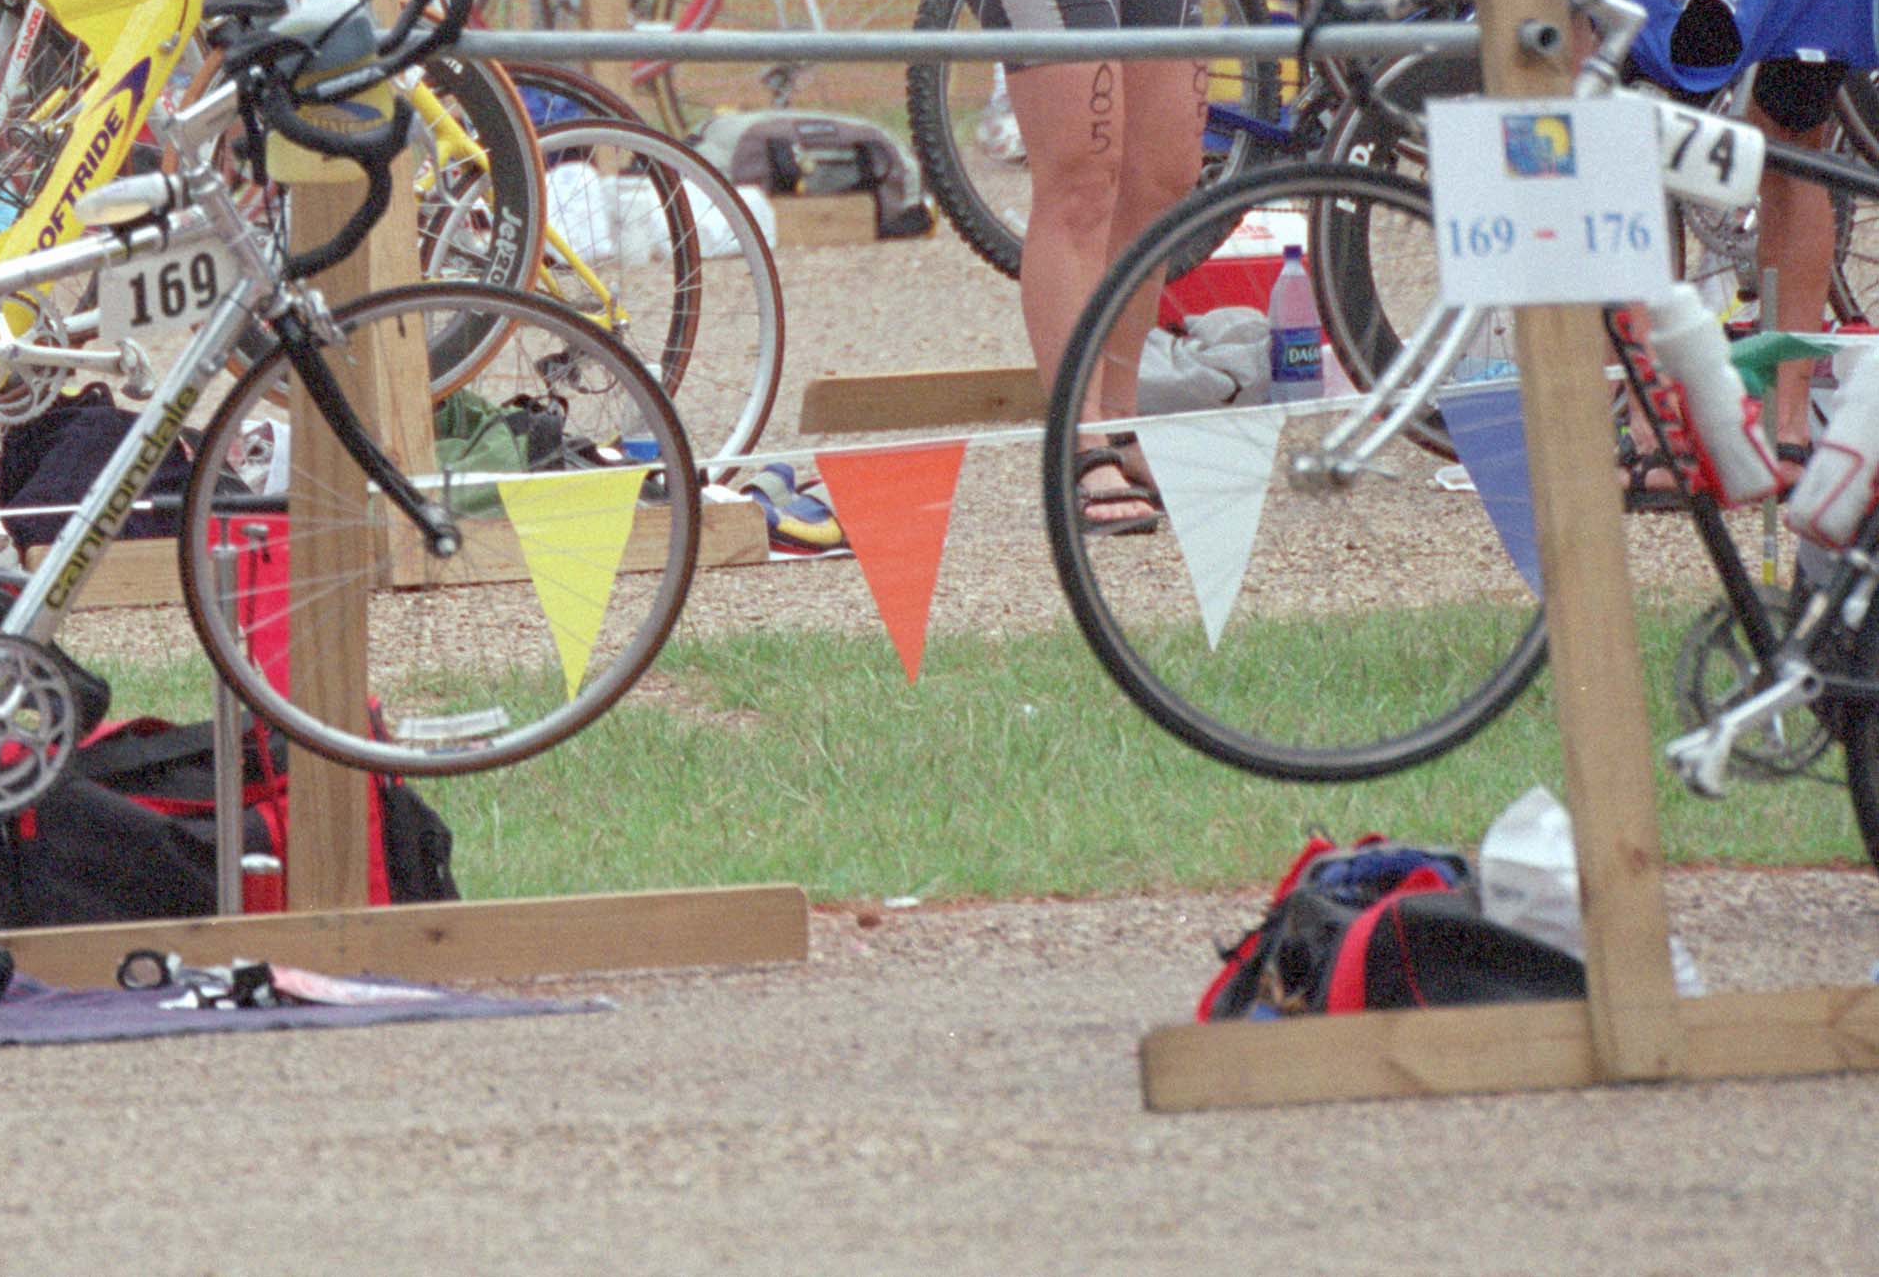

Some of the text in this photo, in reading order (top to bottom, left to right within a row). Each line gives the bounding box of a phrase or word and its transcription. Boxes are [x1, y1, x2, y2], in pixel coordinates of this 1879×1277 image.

[31, 107, 124, 254] OFTRIDE
[1657, 107, 1735, 185] 74
[1448, 216, 1515, 257] 169
[1582, 213, 1652, 254] 176
[128, 251, 219, 328] 169
[45, 386, 198, 609] cannondale
